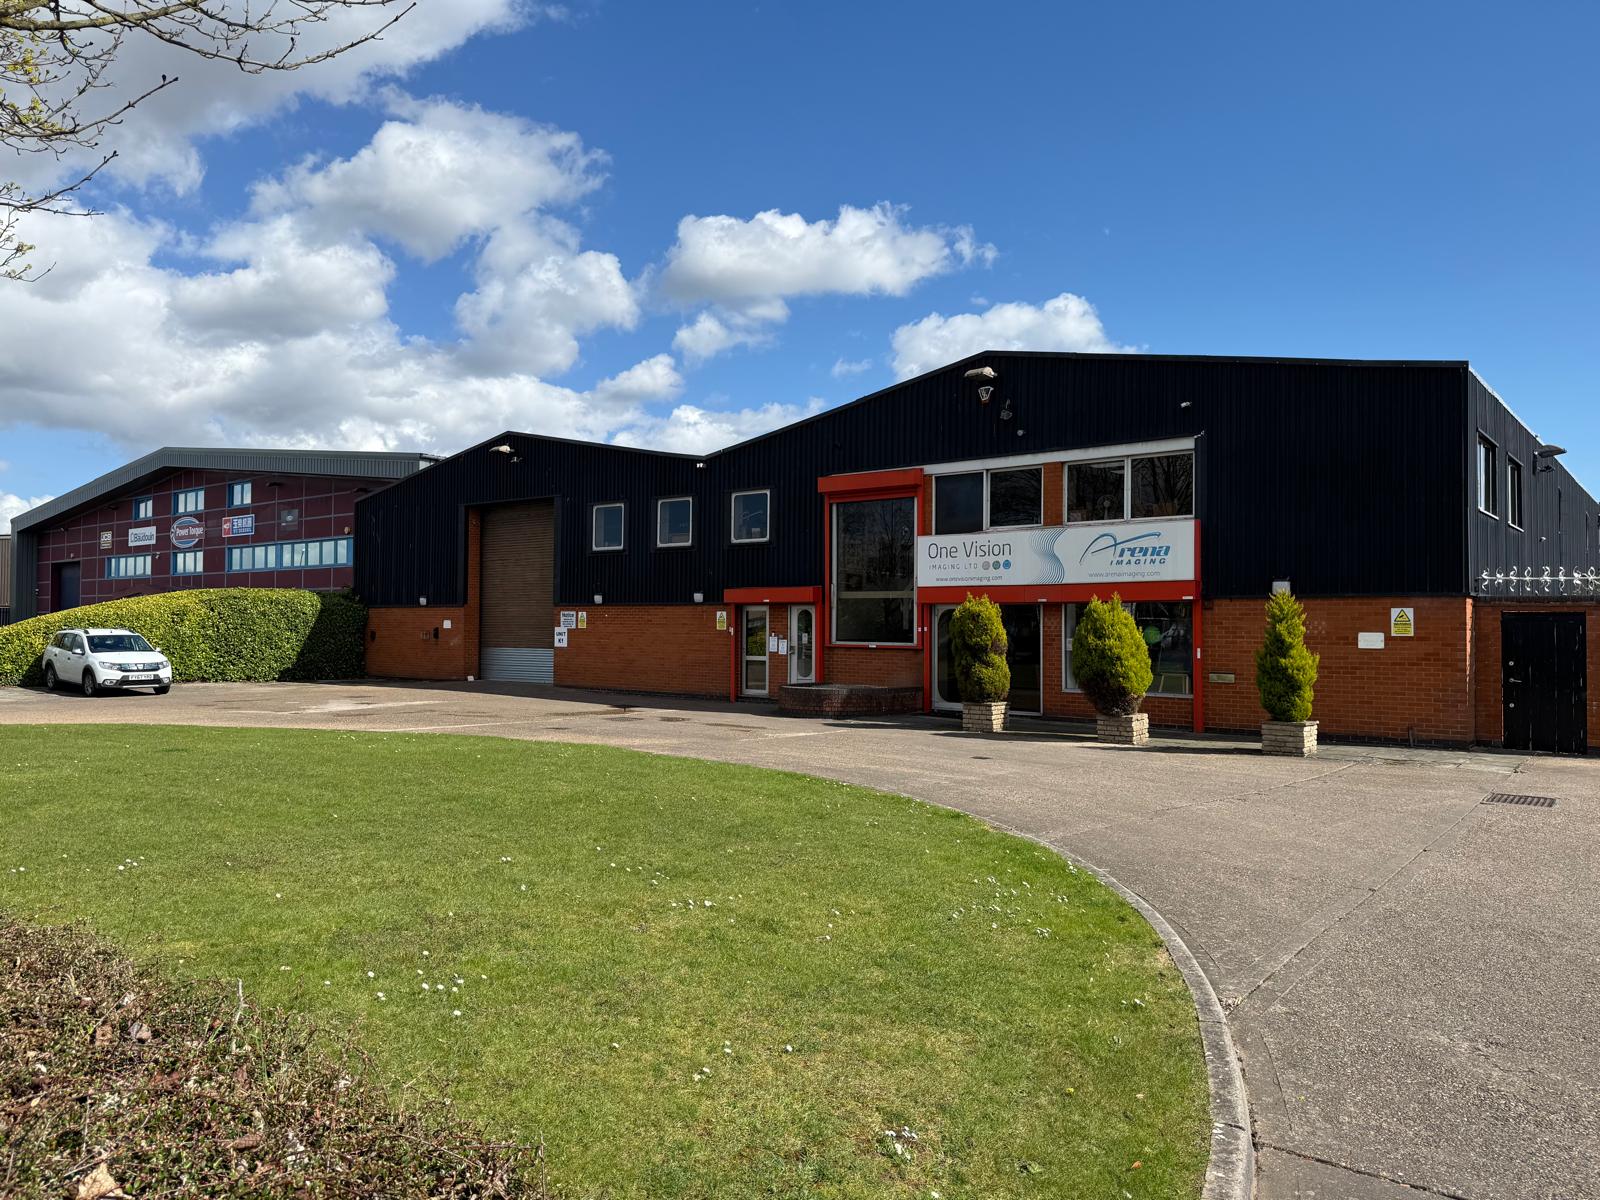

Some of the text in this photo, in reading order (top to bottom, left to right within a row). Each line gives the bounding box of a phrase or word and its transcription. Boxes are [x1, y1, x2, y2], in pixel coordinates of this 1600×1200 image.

[134, 531, 154, 541] Baudouin
[176, 525, 204, 537] Power Torque
[928, 540, 1012, 559] One Vision
[1079, 531, 1171, 566] Arena
[964, 562, 978, 570] LTD
[1110, 558, 1167, 566] IMAGING
